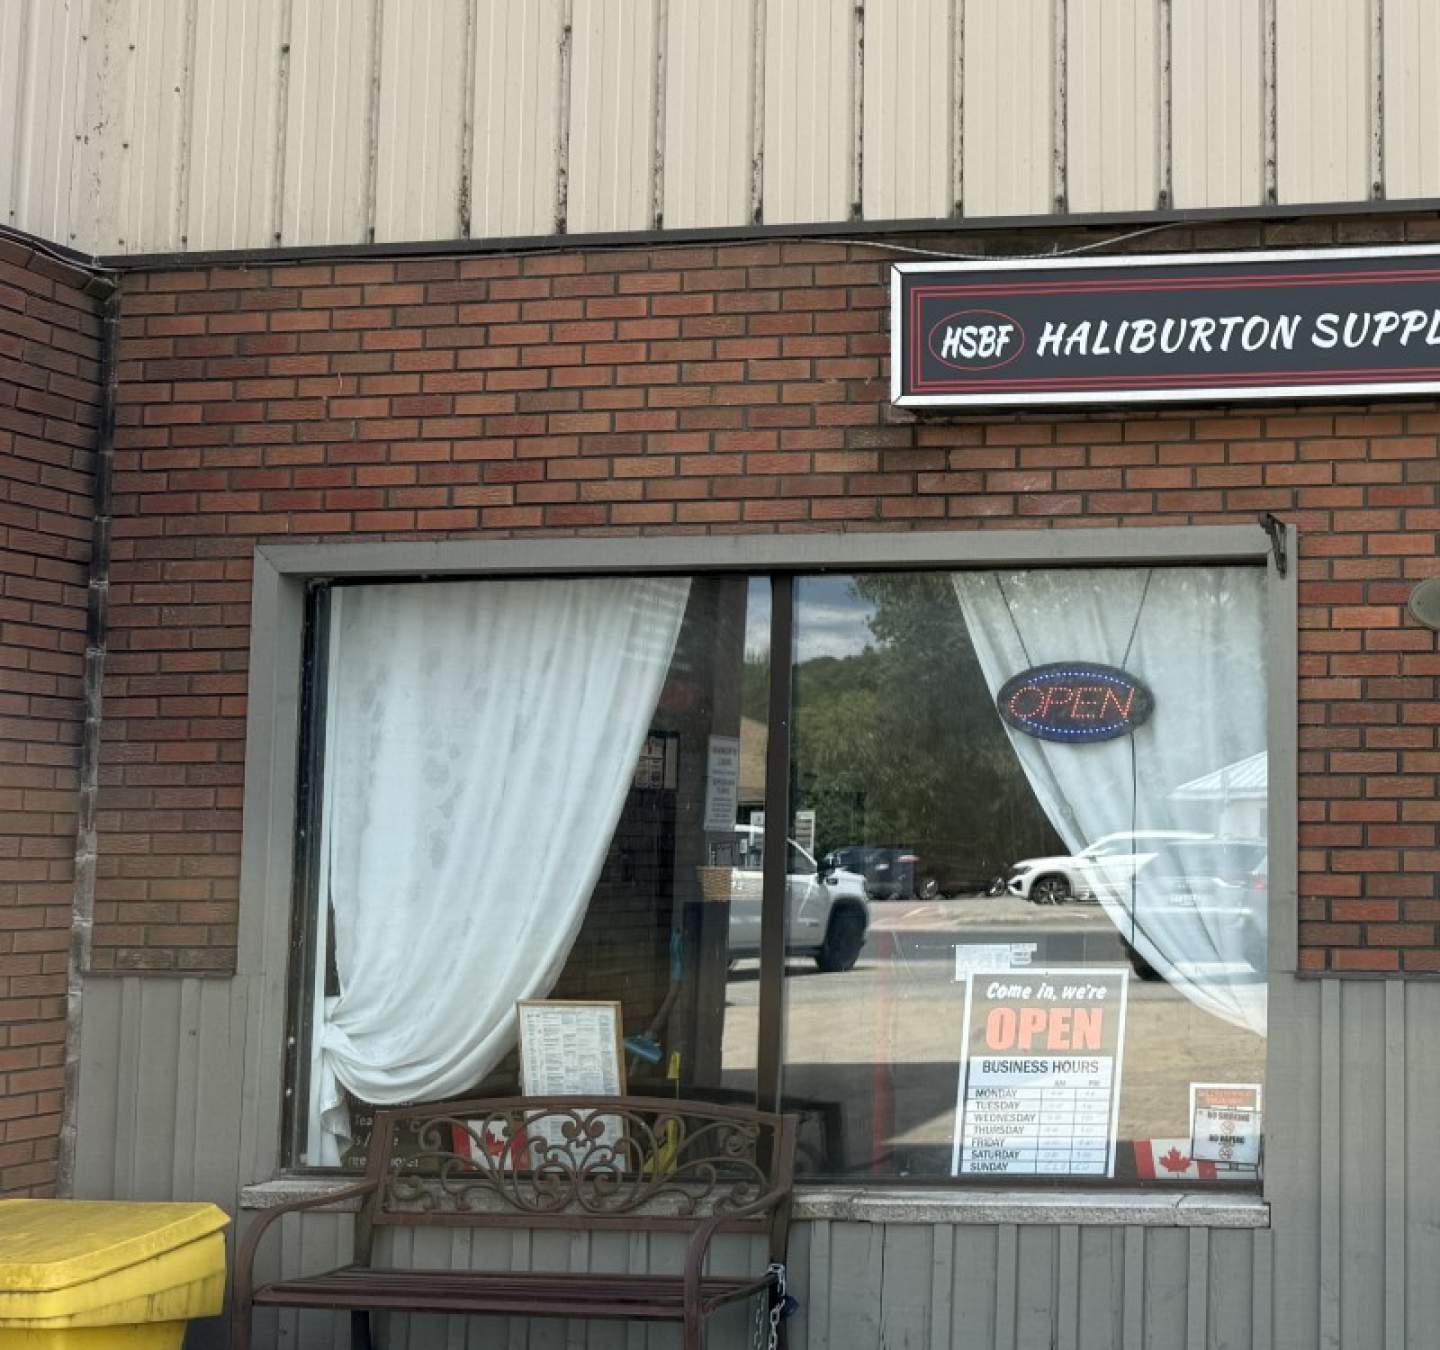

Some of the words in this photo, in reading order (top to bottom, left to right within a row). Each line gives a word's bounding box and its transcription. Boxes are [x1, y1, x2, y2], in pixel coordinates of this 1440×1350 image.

[1036, 314, 1303, 357] HALIBURTON
[941, 324, 1015, 359] HSBF
[1009, 686, 1135, 719] OPEN
[986, 982, 1032, 1000] Come
[1036, 982, 1057, 1001] in,
[1061, 983, 1108, 1000] we're
[986, 1007, 1103, 1050] OPEN
[982, 1060, 1048, 1073] BUSINESS
[1052, 1061, 1099, 1073] HOURS
[975, 1089, 1018, 1098] MONDAY
[976, 1101, 1020, 1110] TUESDAY
[974, 1113, 1036, 1122] WEDNESDAY
[973, 1125, 1025, 1135] THURSDAY
[971, 1138, 1005, 1148] FRIDAY
[971, 1150, 1020, 1159] SATURDAY
[970, 1162, 1009, 1171] SUNDAY
